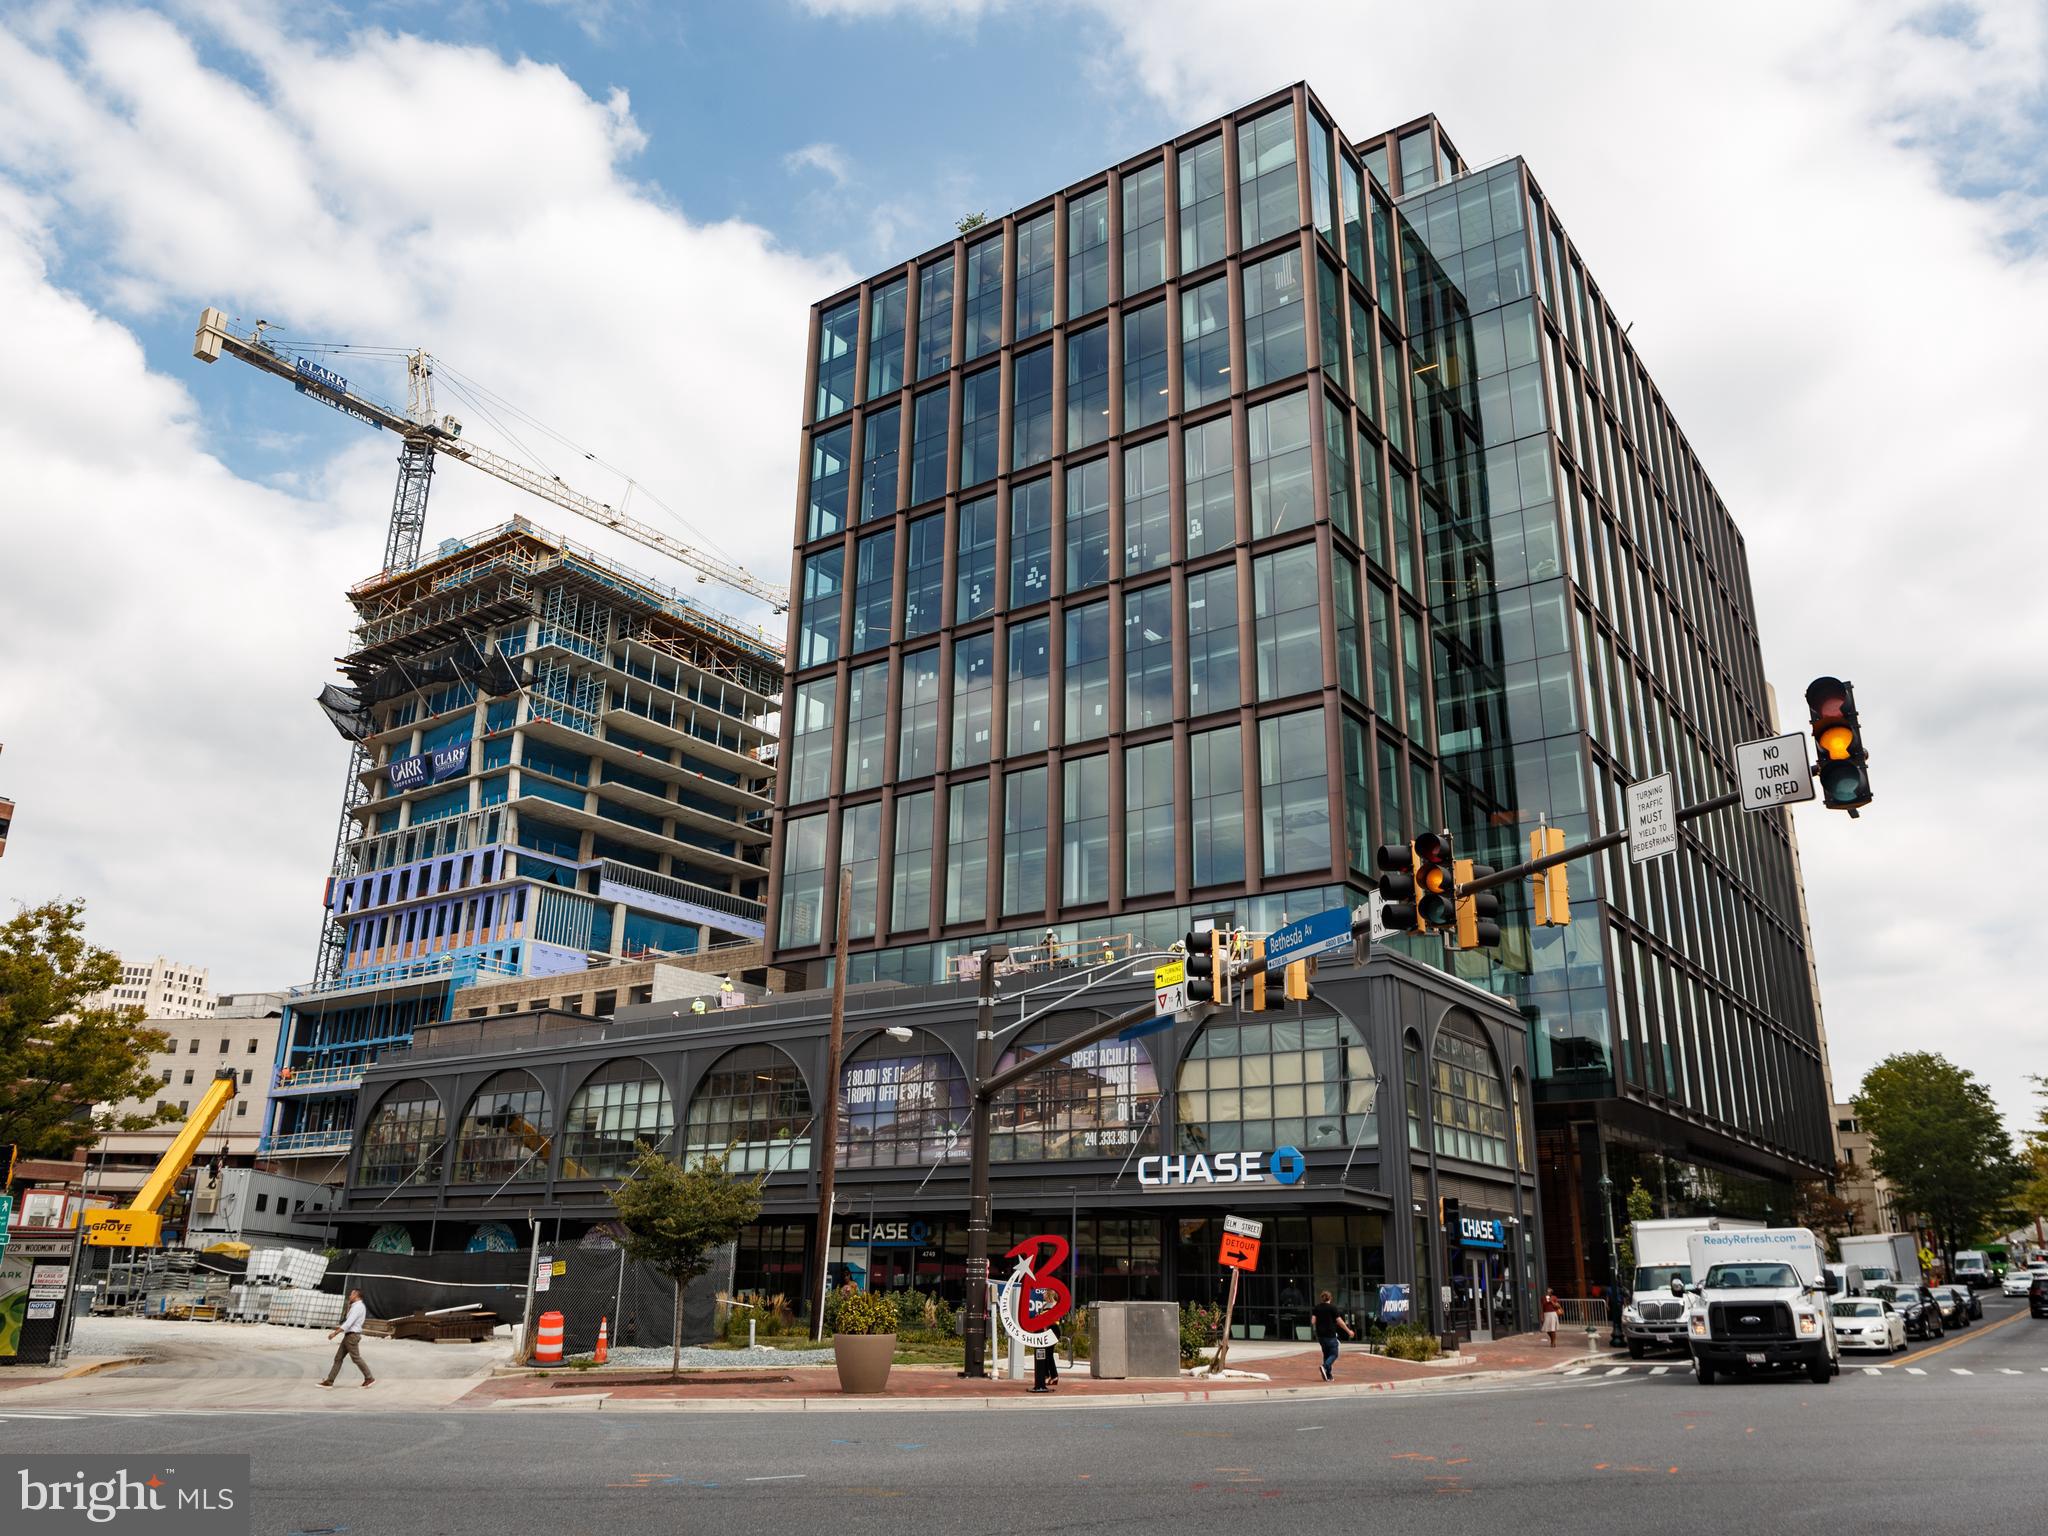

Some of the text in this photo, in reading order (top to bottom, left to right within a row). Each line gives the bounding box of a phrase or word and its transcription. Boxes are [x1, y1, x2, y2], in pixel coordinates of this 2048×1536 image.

[299, 358, 345, 387] CLARK
[304, 388, 374, 425] MILLER & LONG
[1763, 746, 1779, 761] NO
[391, 758, 423, 782] CARR
[1758, 763, 1790, 780] TURN
[1636, 785, 1663, 801] TURNING
[1755, 780, 1799, 801] ON RED
[1638, 797, 1664, 813] TRAFFIC
[1640, 810, 1663, 826] MUST
[1638, 823, 1668, 839] YIELD TO
[1633, 833, 1676, 853] PEDESTRIANS
[1270, 923, 1313, 954] Bethesda Av
[1164, 974, 1182, 984] VEHICLES
[1071, 1046, 1137, 1069] SPECTACULAR
[882, 1067, 893, 1084] SF
[894, 1066, 905, 1083] OF
[847, 1086, 876, 1104] TROPHY
[907, 1081, 934, 1100] SPACE
[1117, 1102, 1137, 1121] OUT
[1138, 1151, 1264, 1185] CHASE
[92, 1223, 132, 1232] GROVE
[849, 1223, 909, 1240] CHASE
[1226, 1219, 1260, 1234] ELM STREET
[1461, 1217, 1495, 1240] CHASE
[25, 1244, 56, 1252] WOODMONT
[60, 1244, 71, 1252] AVE
[1226, 1238, 1255, 1250] DETOUR
[1703, 1233, 1797, 1247] ReadyRefresh.com
[1004, 1316, 1020, 1337] ARTS
[1022, 1334, 1049, 1346] SHINE
